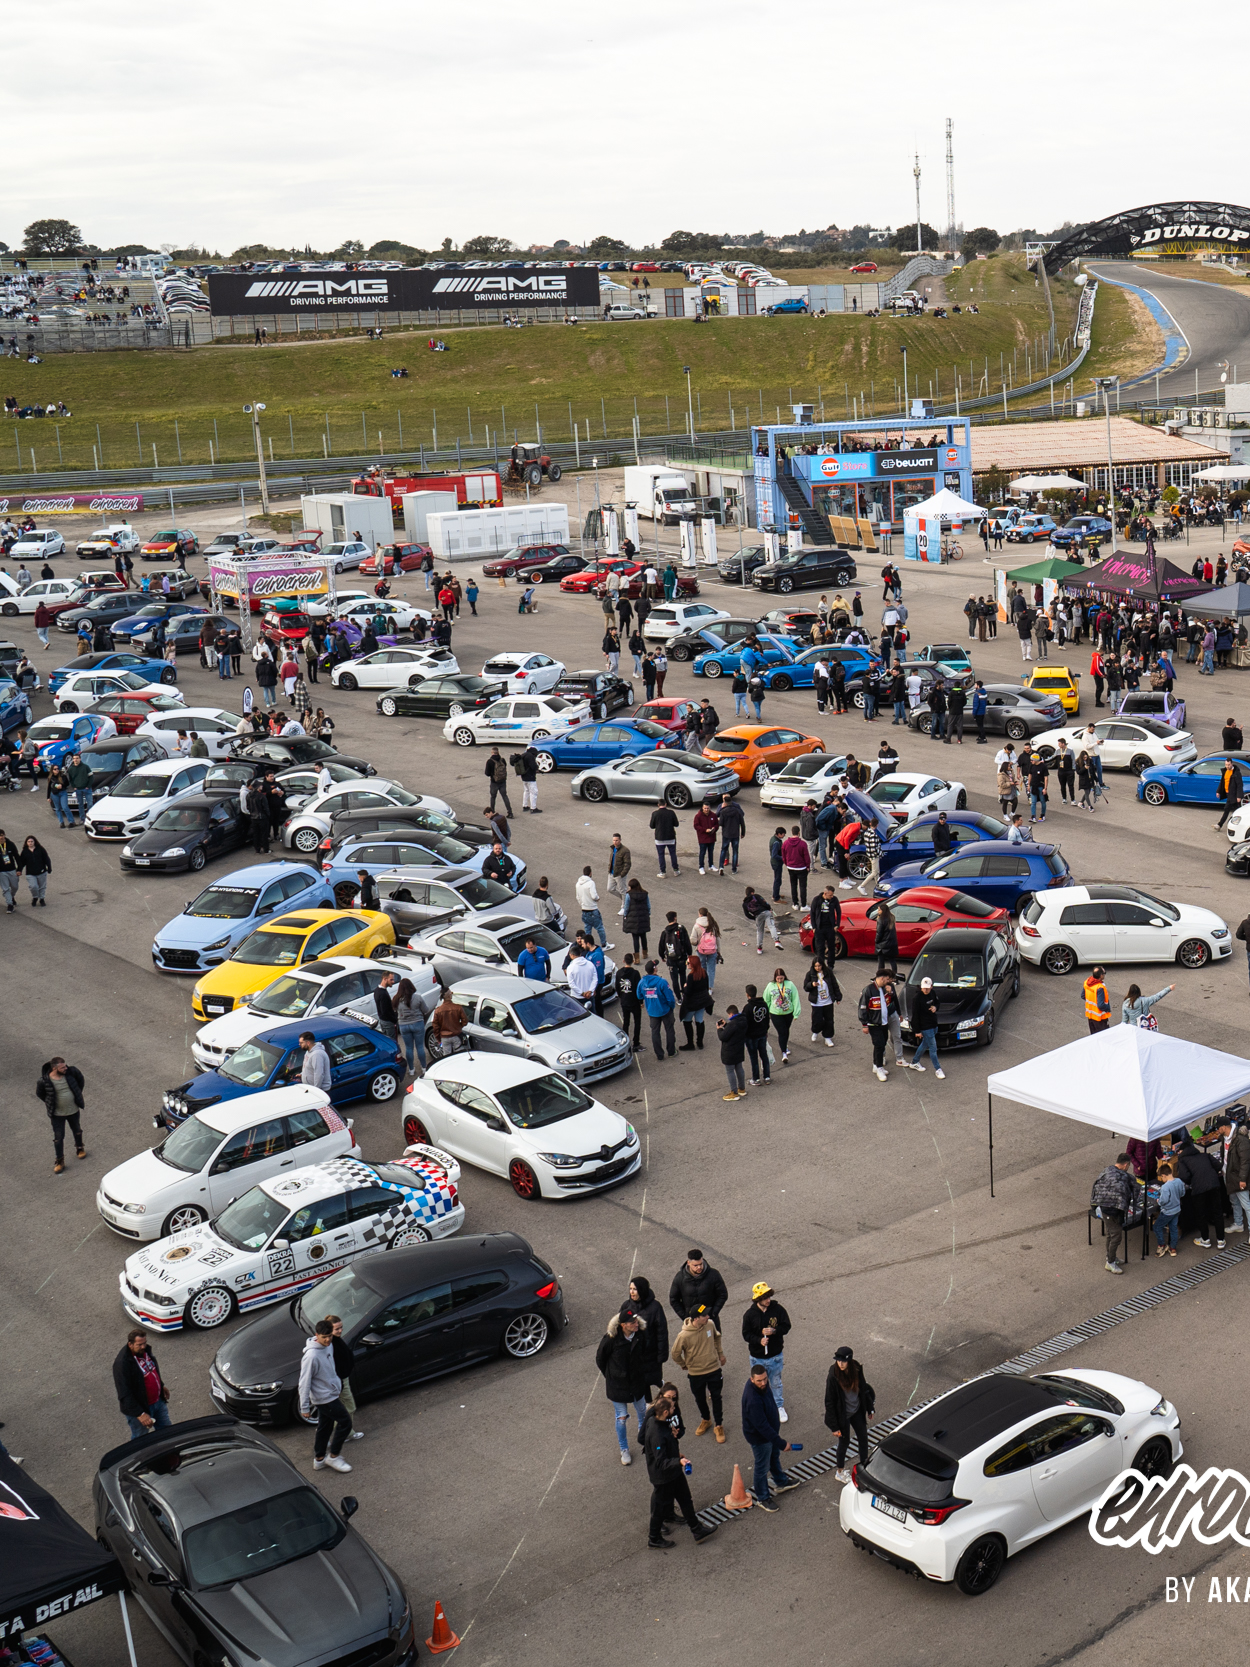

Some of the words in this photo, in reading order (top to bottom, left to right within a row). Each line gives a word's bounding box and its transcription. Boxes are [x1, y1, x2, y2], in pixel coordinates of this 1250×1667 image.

[1141, 224, 1250, 244] DUNLOP
[298, 278, 389, 294] AMG
[482, 275, 567, 291] AMG
[290, 297, 326, 306] DRIVING
[327, 295, 389, 305] PERFORMANCE
[474, 293, 508, 301] DRIVING
[509, 291, 568, 300] PERFORMANCE
[843, 462, 868, 471] Store
[919, 534, 929, 548] 20
[203, 1253, 222, 1265] 22
[269, 1249, 293, 1262] DEKRA
[272, 1258, 294, 1275] 22
[292, 1269, 314, 1282] FAST
[313, 1263, 329, 1274] AND
[329, 1259, 348, 1272] NICE
[36, 1583, 103, 1623] DETAIL
